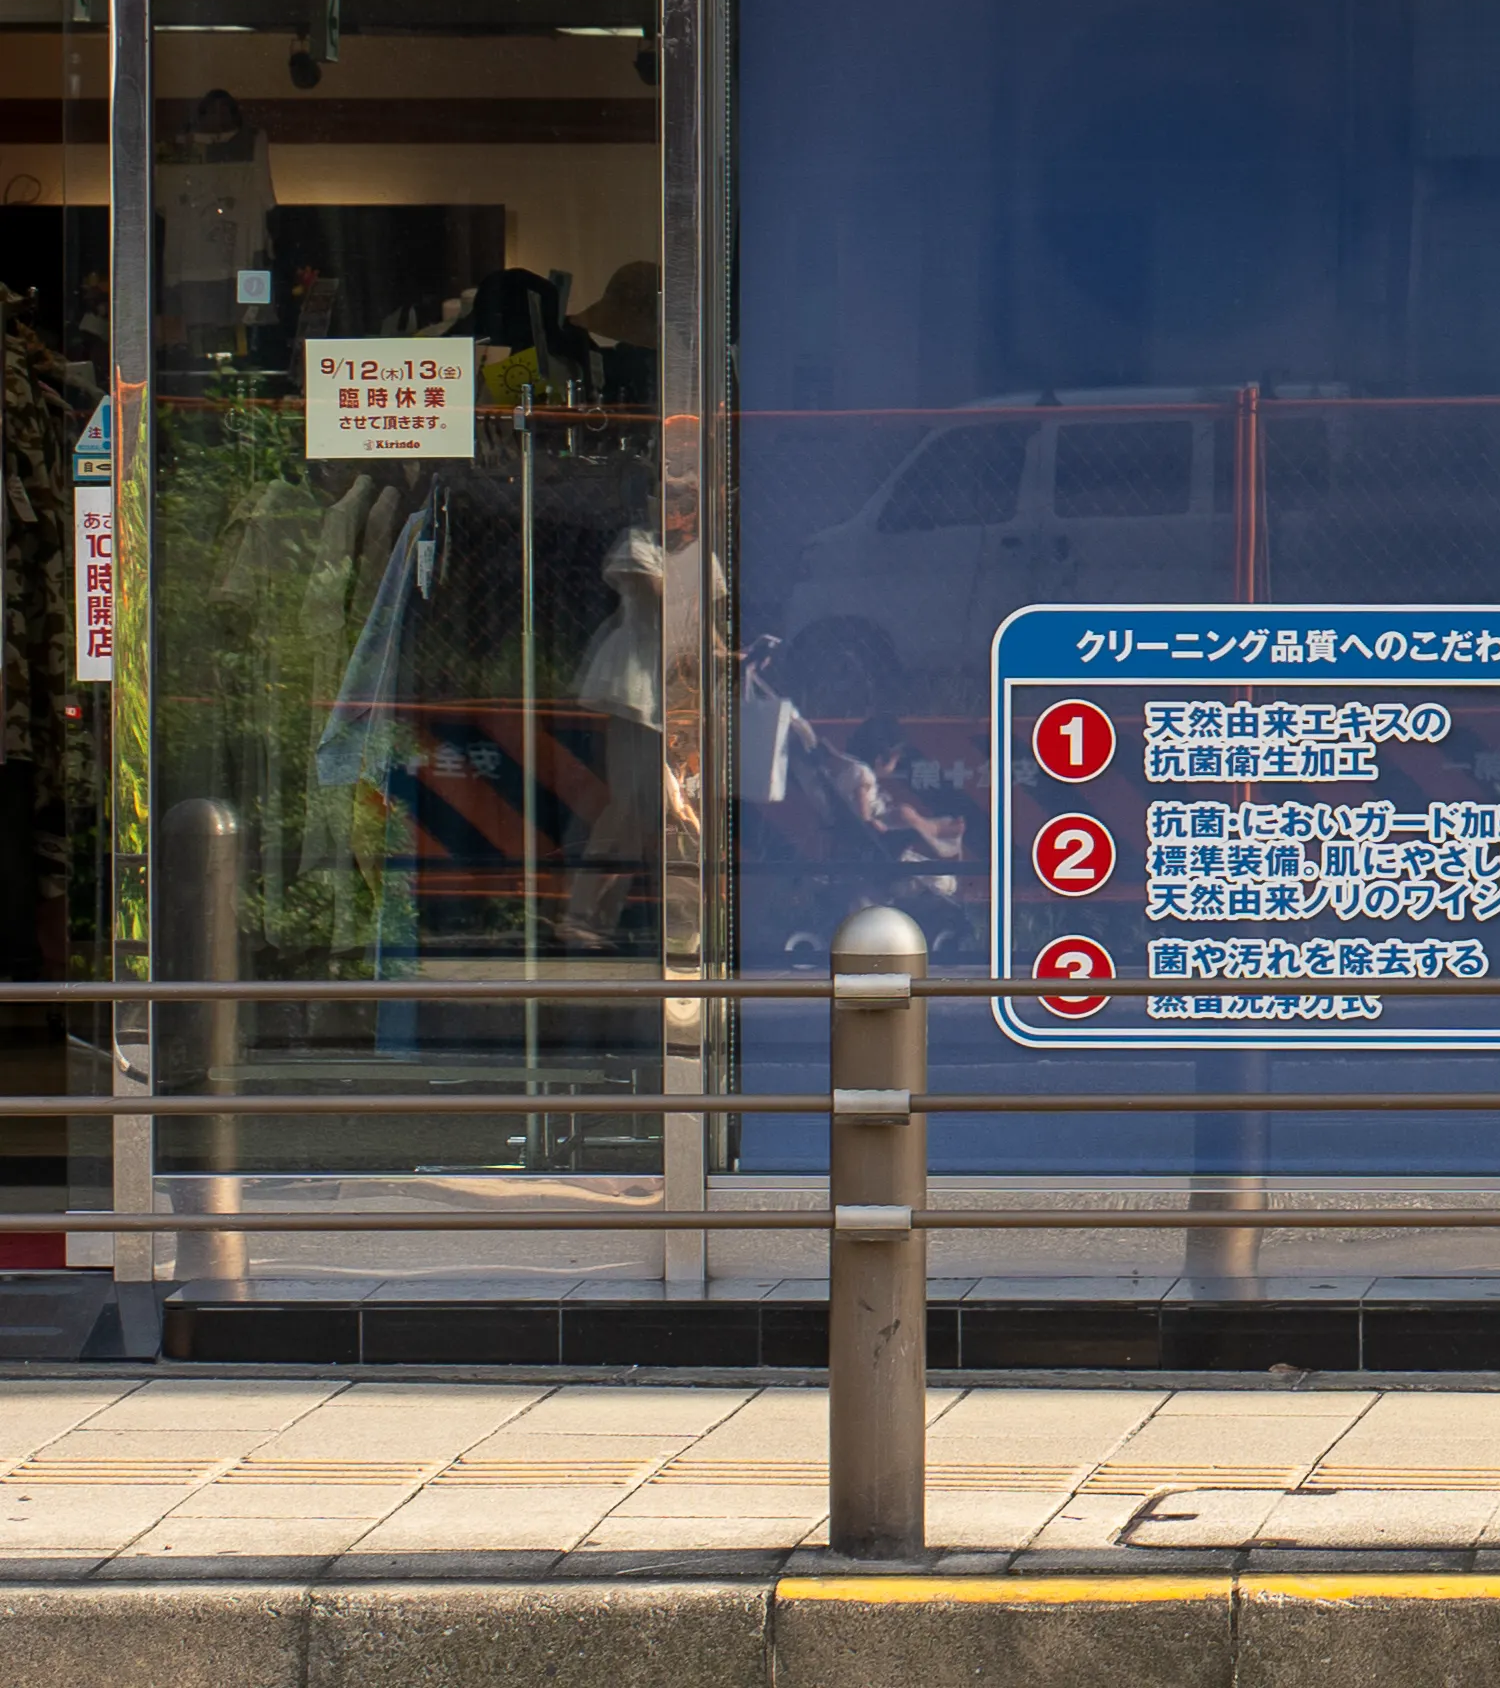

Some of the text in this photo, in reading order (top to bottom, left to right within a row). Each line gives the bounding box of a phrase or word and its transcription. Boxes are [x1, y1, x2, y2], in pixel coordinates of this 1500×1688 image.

[339, 387, 445, 409] 臨時休業
[339, 416, 447, 429] させて頂きます。
[376, 440, 420, 449] Kirindo
[1058, 703, 1449, 765] 1 天然由来エキスの
[1147, 743, 1377, 780] 抗菌衛生加工
[1054, 829, 1095, 880] 2
[1152, 942, 1486, 977] 菌や汚れを除去する
